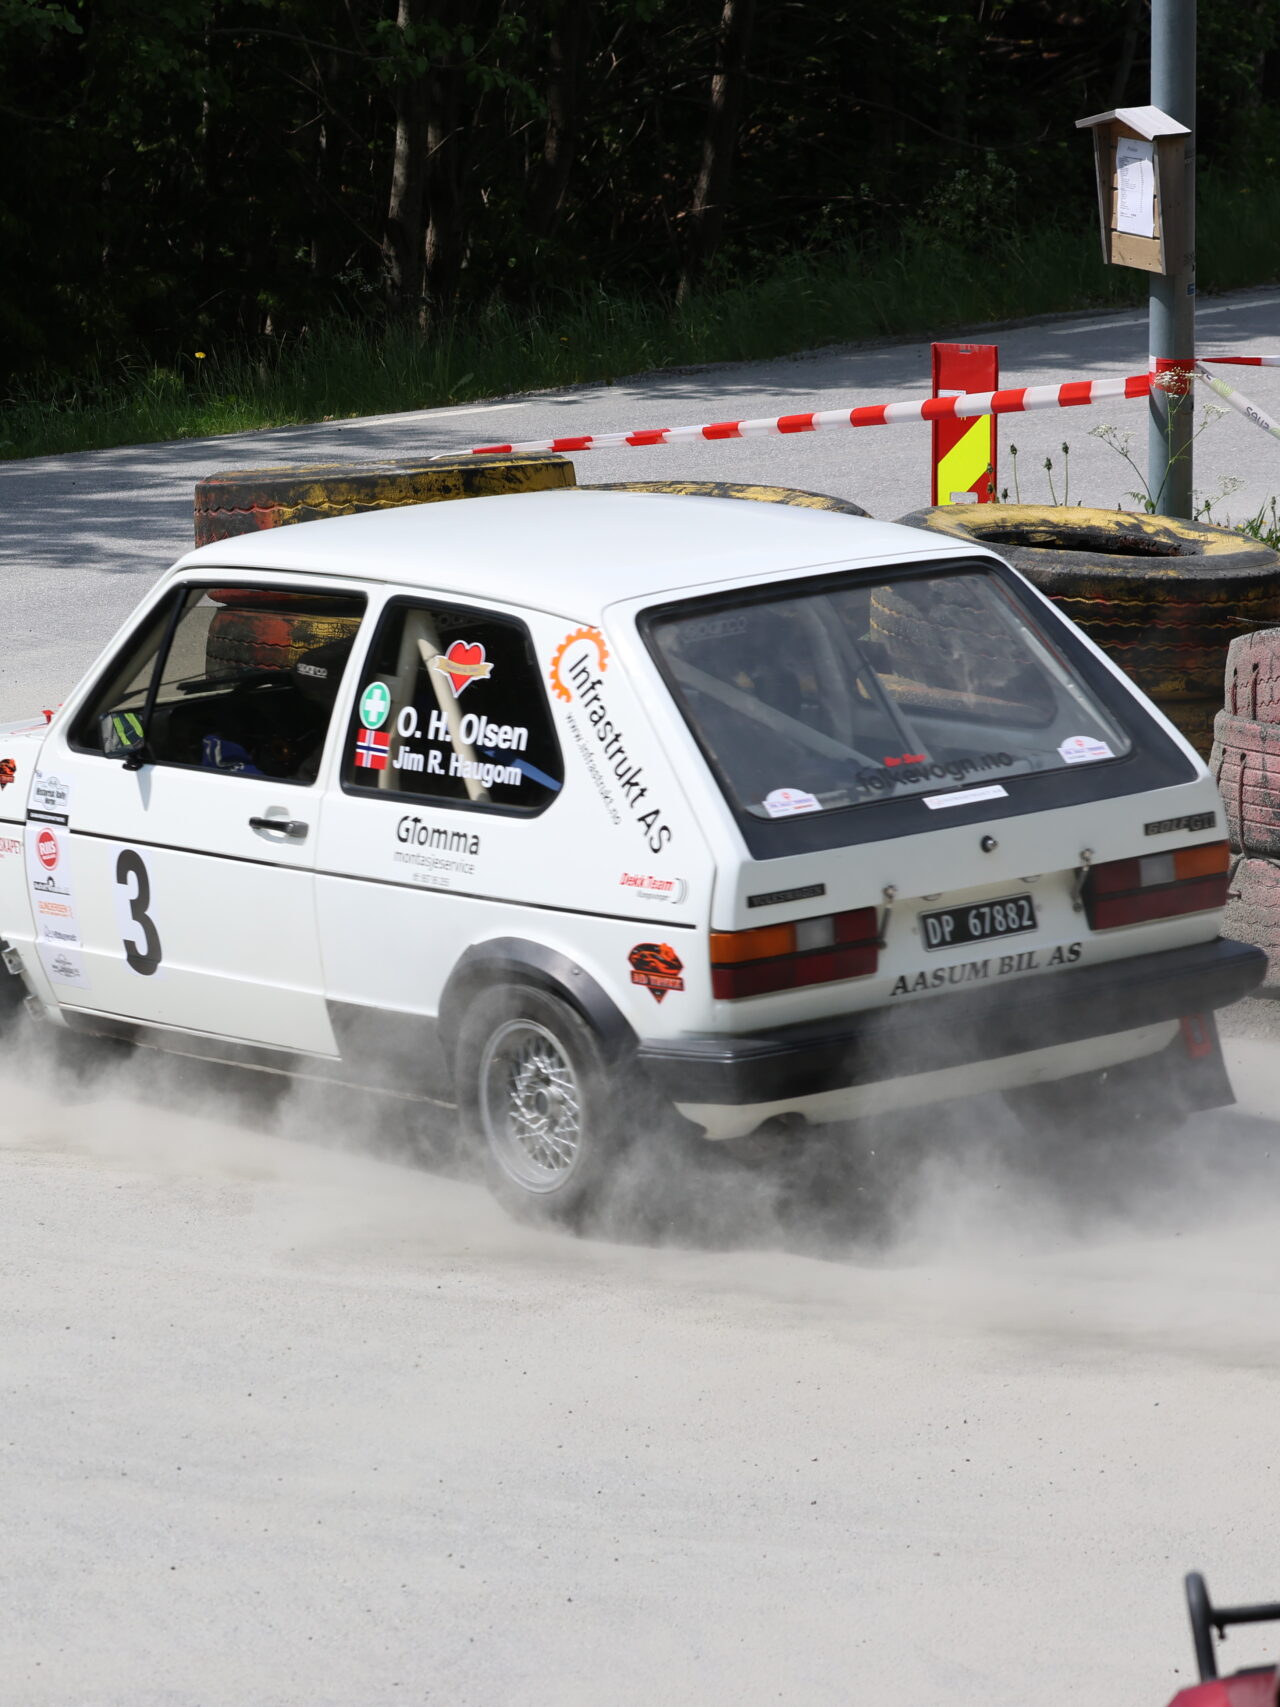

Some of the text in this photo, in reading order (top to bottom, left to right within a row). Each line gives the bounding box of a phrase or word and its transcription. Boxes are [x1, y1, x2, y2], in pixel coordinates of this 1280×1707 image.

[397, 706, 529, 751] O. H. Olsen
[393, 745, 522, 788] Jim R. Haugom
[570, 653, 648, 808] Infrastrukt
[637, 808, 672, 854] AS
[855, 752, 1013, 793] folkevogn.no
[116, 849, 162, 976] 3
[926, 900, 1033, 944] DP 67882
[889, 942, 1082, 997] AASUM BIL AS
